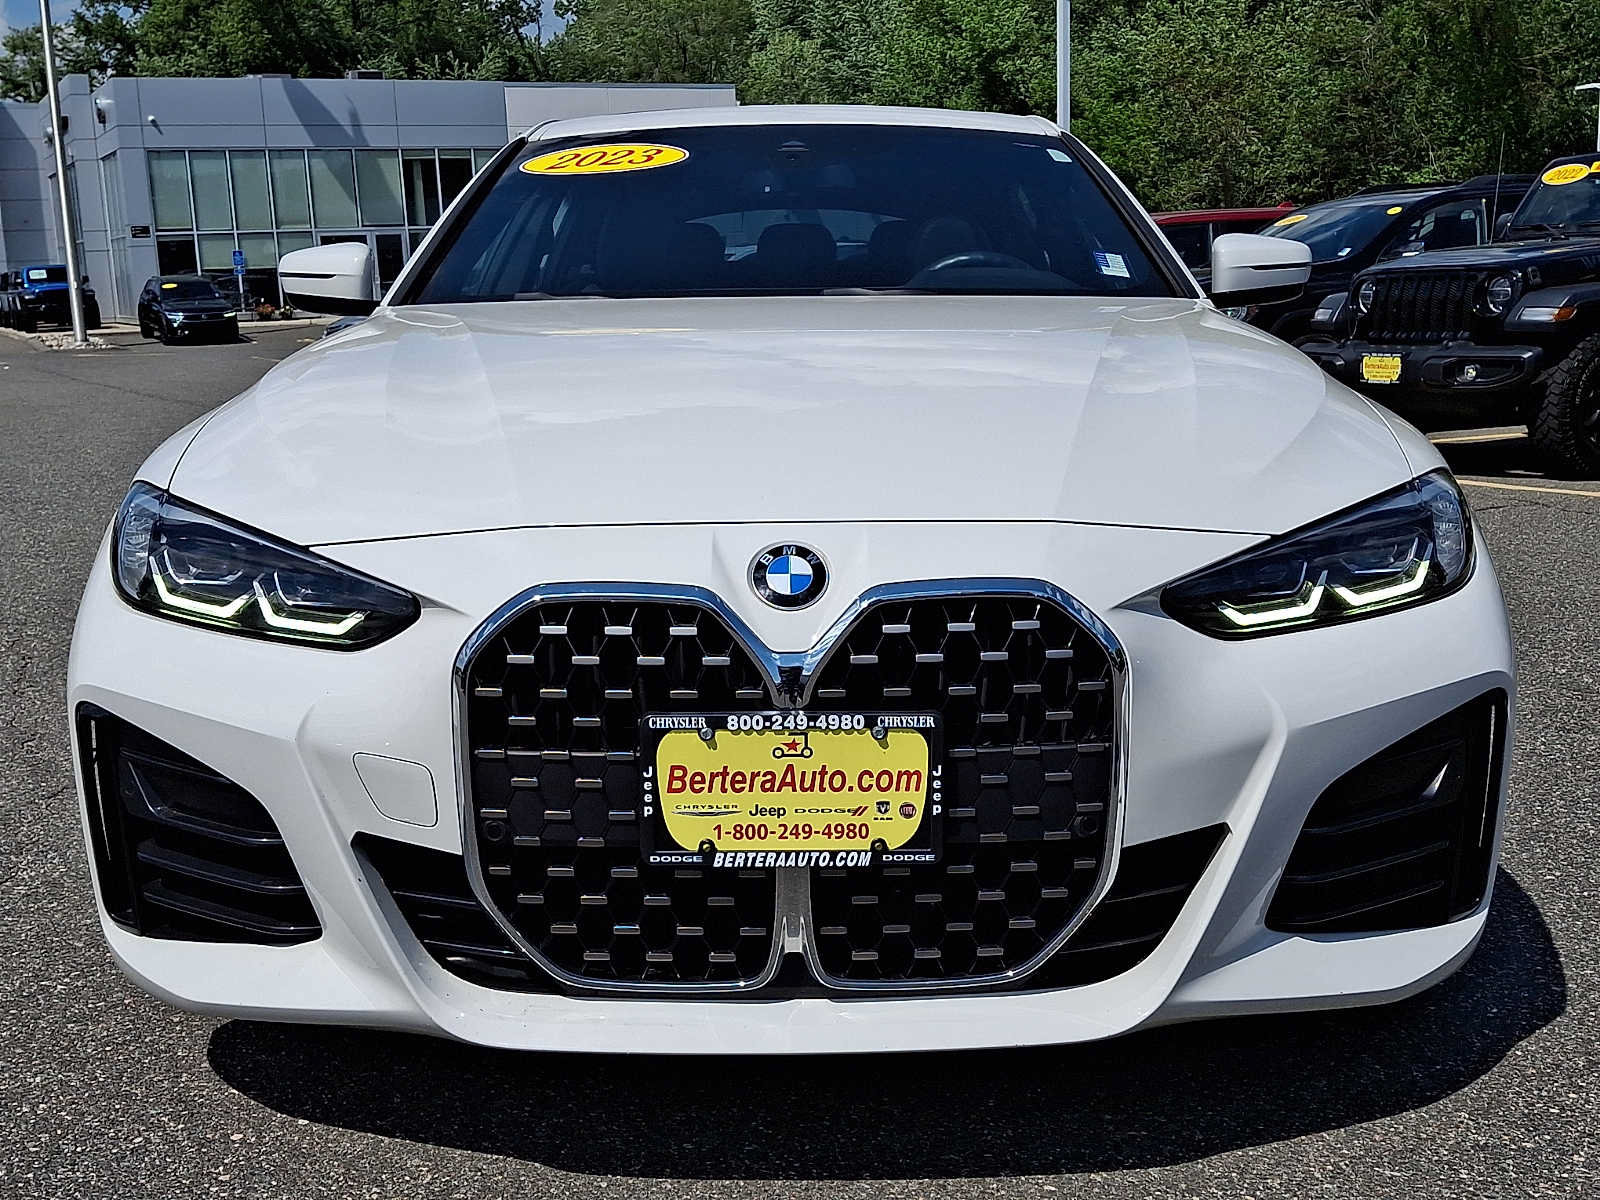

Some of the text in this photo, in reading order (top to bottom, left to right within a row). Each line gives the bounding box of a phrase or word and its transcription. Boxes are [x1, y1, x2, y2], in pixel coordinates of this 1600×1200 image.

[544, 149, 664, 170] 2023
[760, 546, 820, 565] BMW
[648, 717, 707, 729] CHRYSLER
[727, 715, 865, 730] 800-249-4980
[877, 716, 935, 728] CHRYSLER
[666, 764, 922, 794] BerteraAuto.com
[643, 766, 653, 817] Jeep
[932, 765, 942, 815] Jeep
[749, 804, 787, 819] Jeep
[713, 823, 870, 840] 1-800-249-4980
[713, 852, 872, 867] BERTERAAUTO.COM
